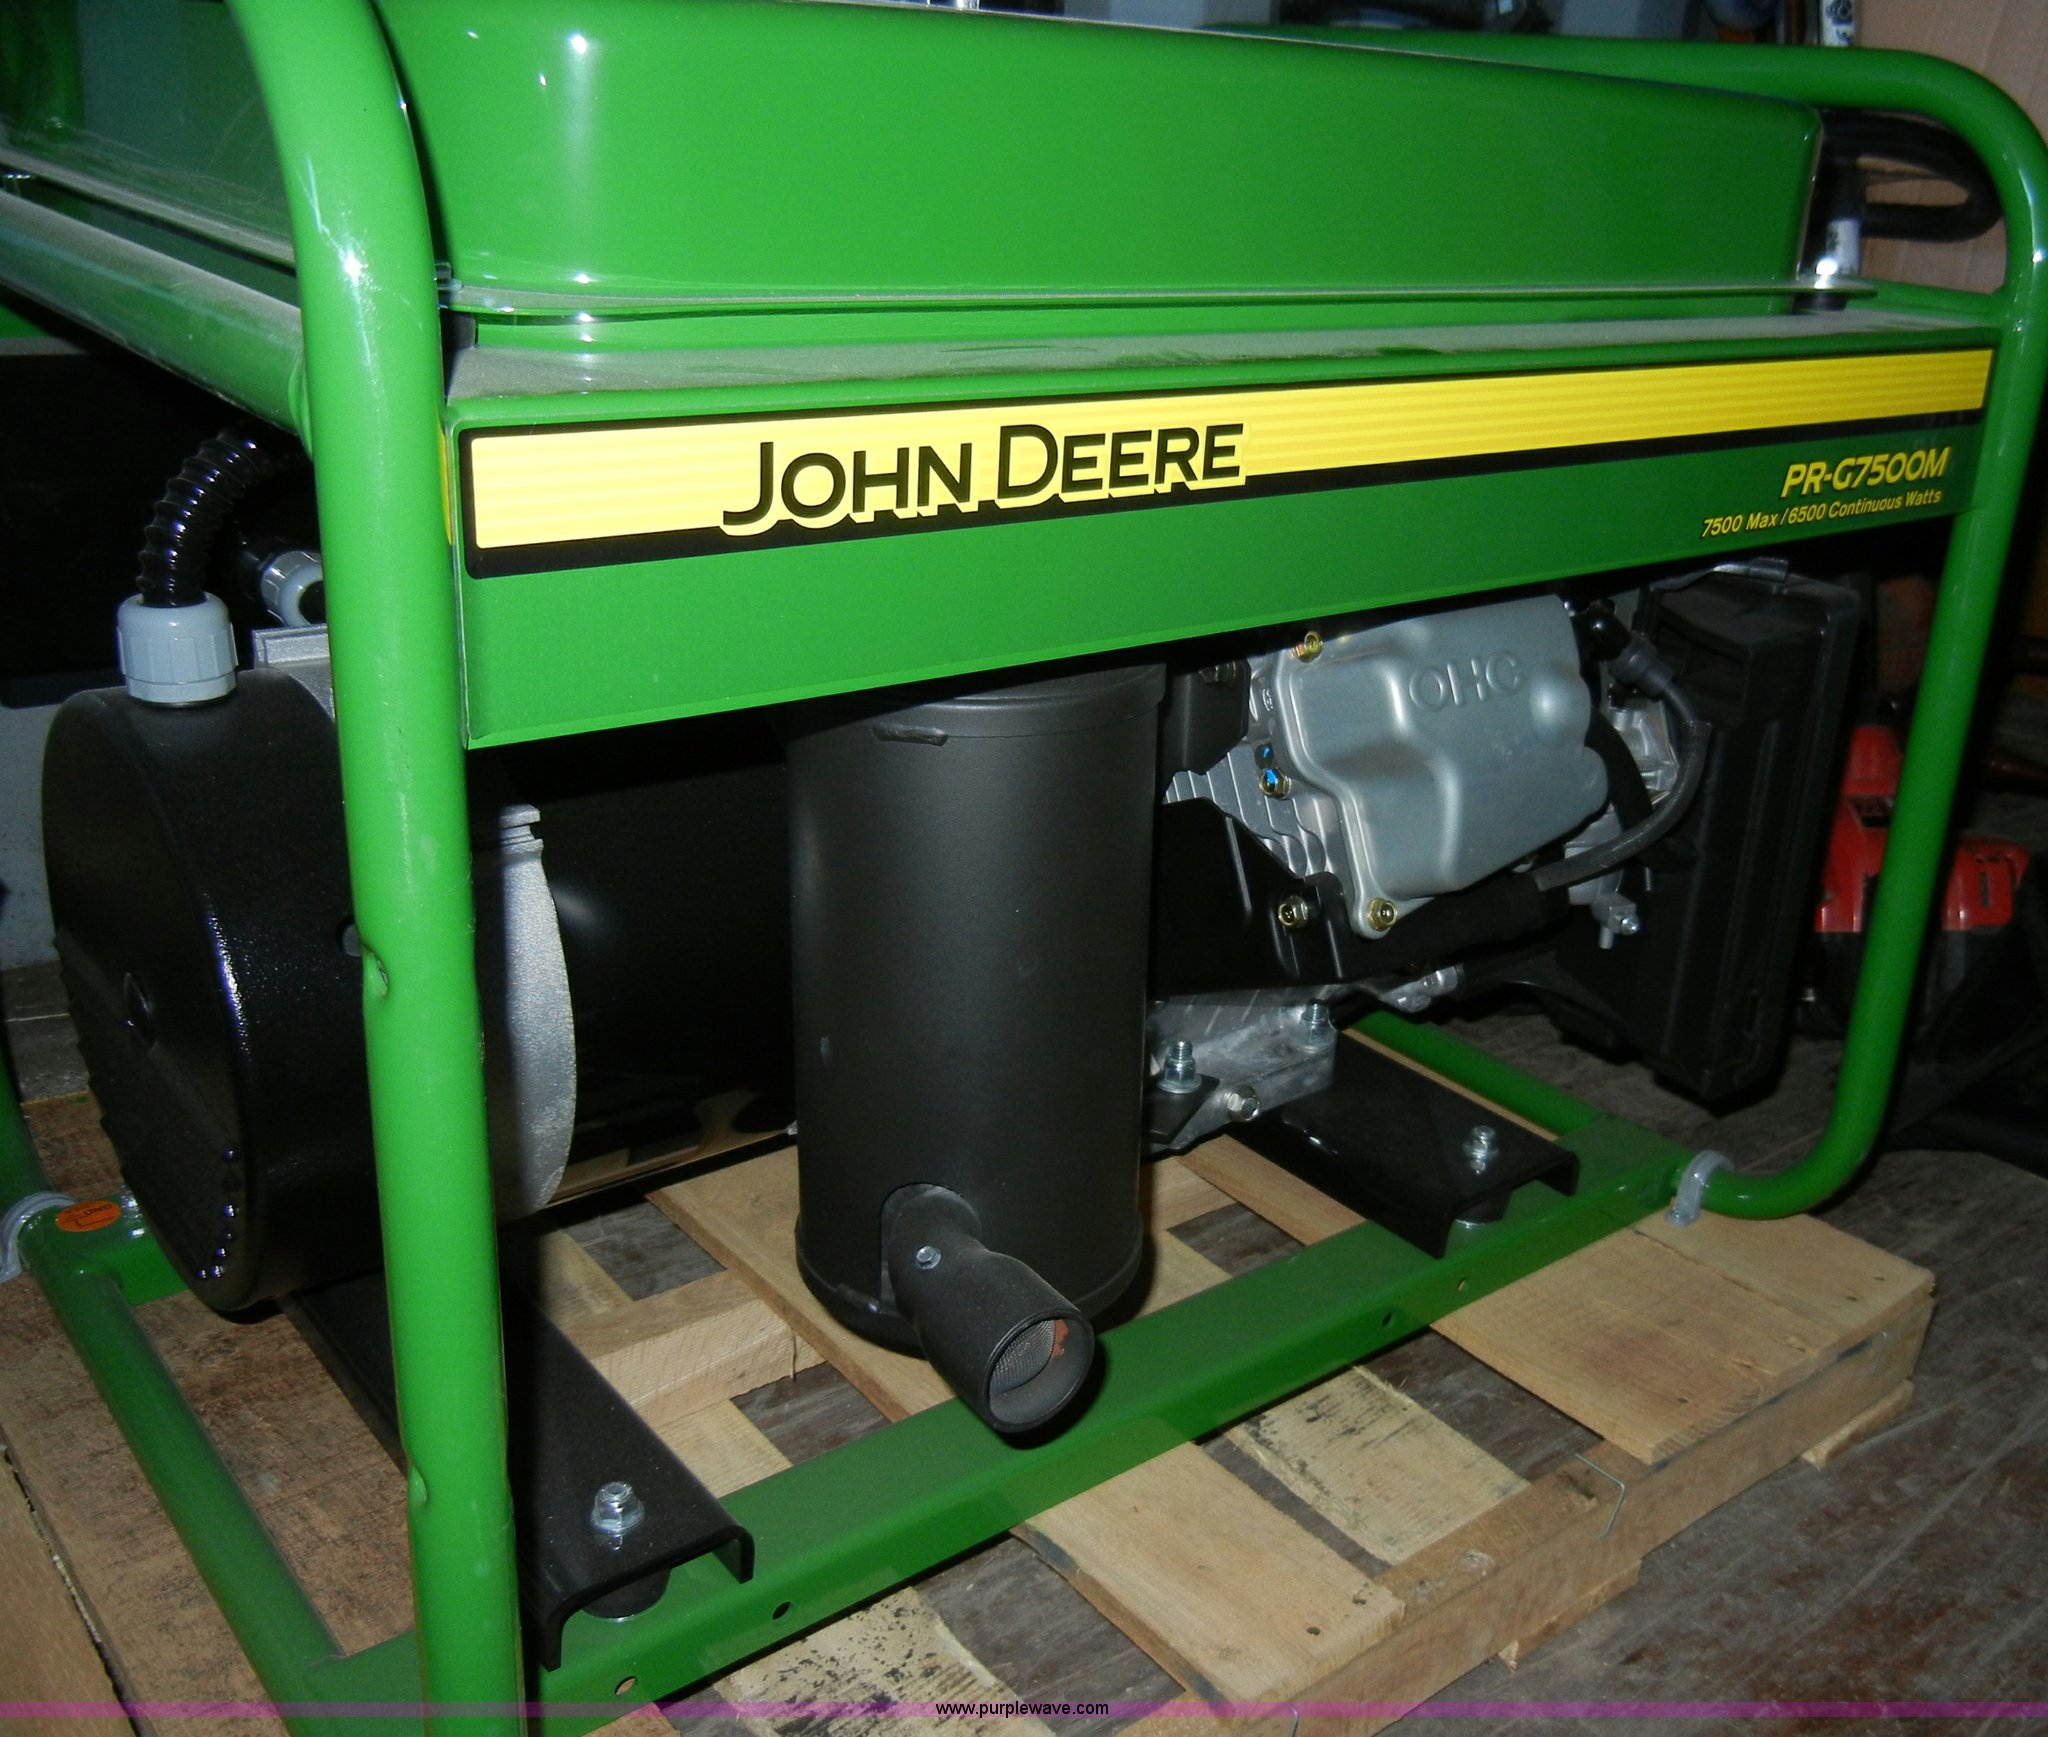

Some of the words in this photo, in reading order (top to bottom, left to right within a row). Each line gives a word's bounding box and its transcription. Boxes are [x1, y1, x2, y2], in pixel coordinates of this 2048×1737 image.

[722, 441, 973, 530] JOHN
[996, 423, 1244, 501] DEERE
[1781, 446, 1951, 498] PR-G7500M
[1701, 514, 1743, 538] 7500
[1746, 510, 1777, 531] Max
[1828, 493, 1902, 519] Continuous
[1905, 488, 1942, 508] Watts
[1408, 651, 1523, 711] OHC
